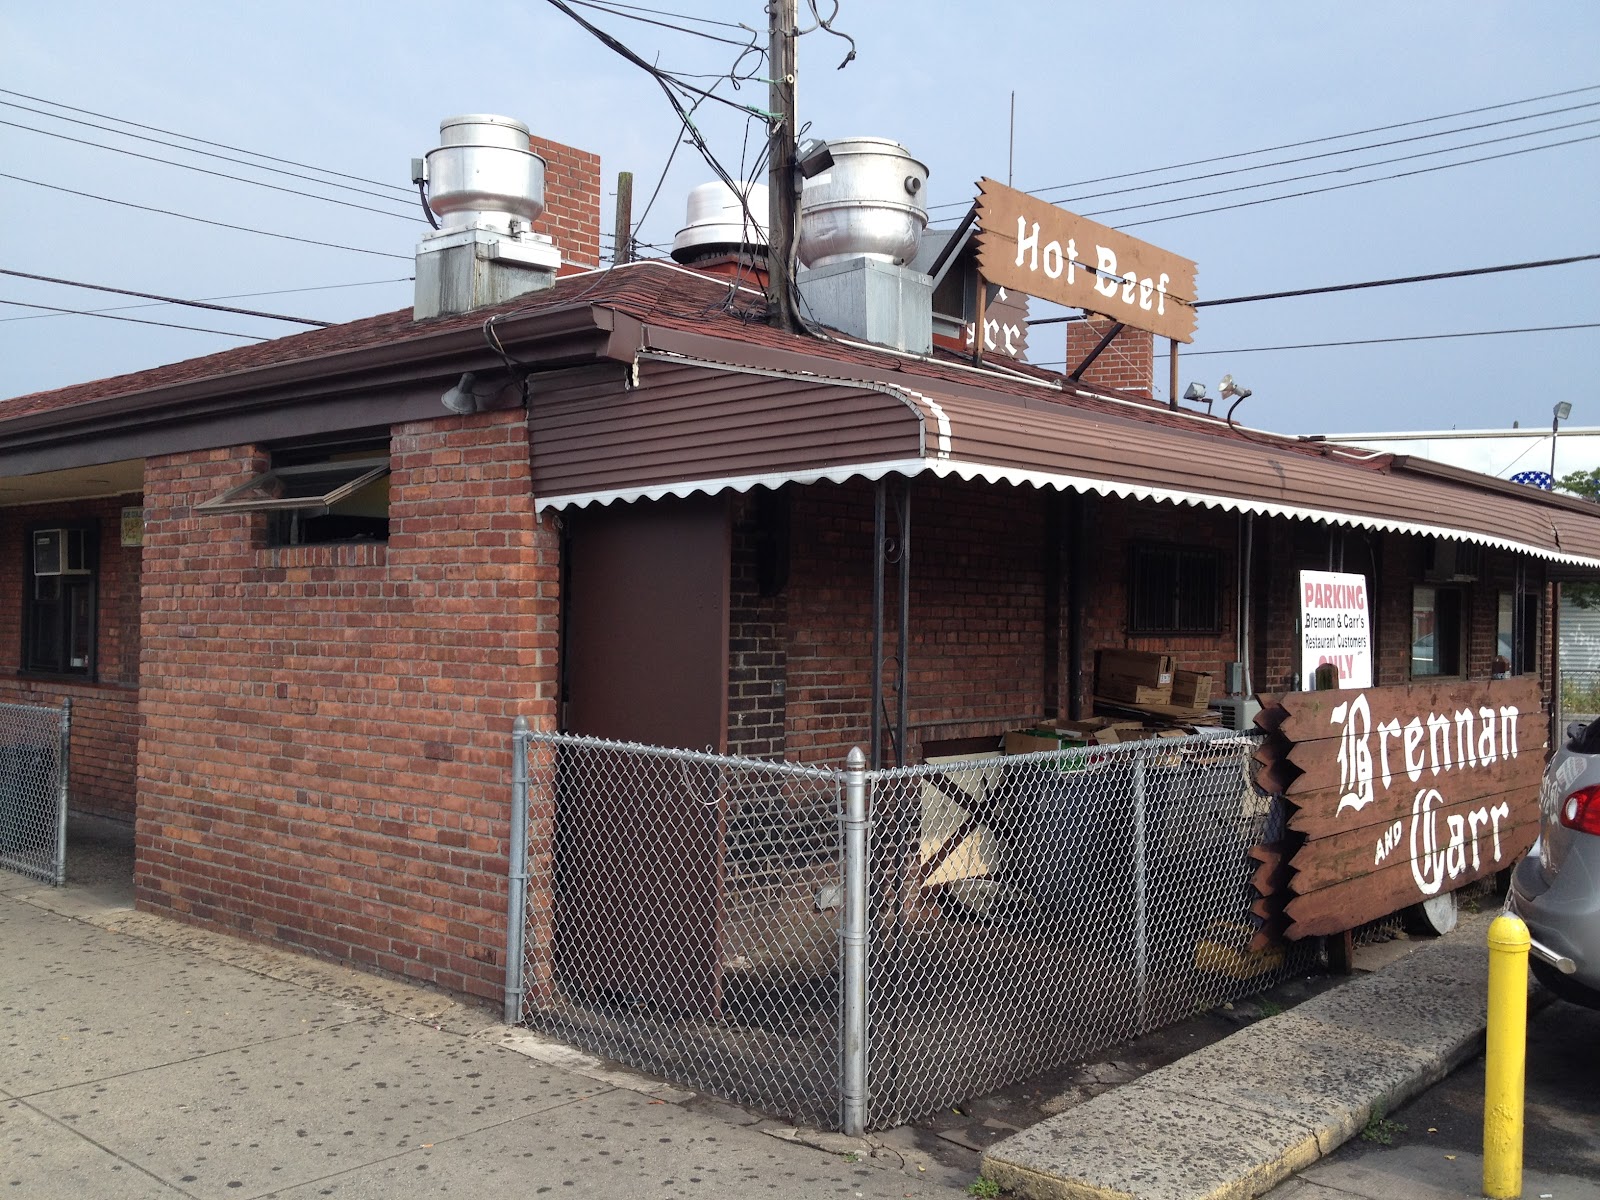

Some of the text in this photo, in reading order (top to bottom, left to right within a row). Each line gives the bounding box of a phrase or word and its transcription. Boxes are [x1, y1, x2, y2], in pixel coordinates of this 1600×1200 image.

[1015, 215, 1170, 316] Hot Beef
[1304, 582, 1365, 610] PARKING
[1304, 612, 1365, 629] Brennan & Carr's
[1305, 633, 1336, 649] Restaurant
[1330, 692, 1519, 818] Brennan
[1374, 820, 1403, 866] AND
[1409, 788, 1510, 895] Carr
